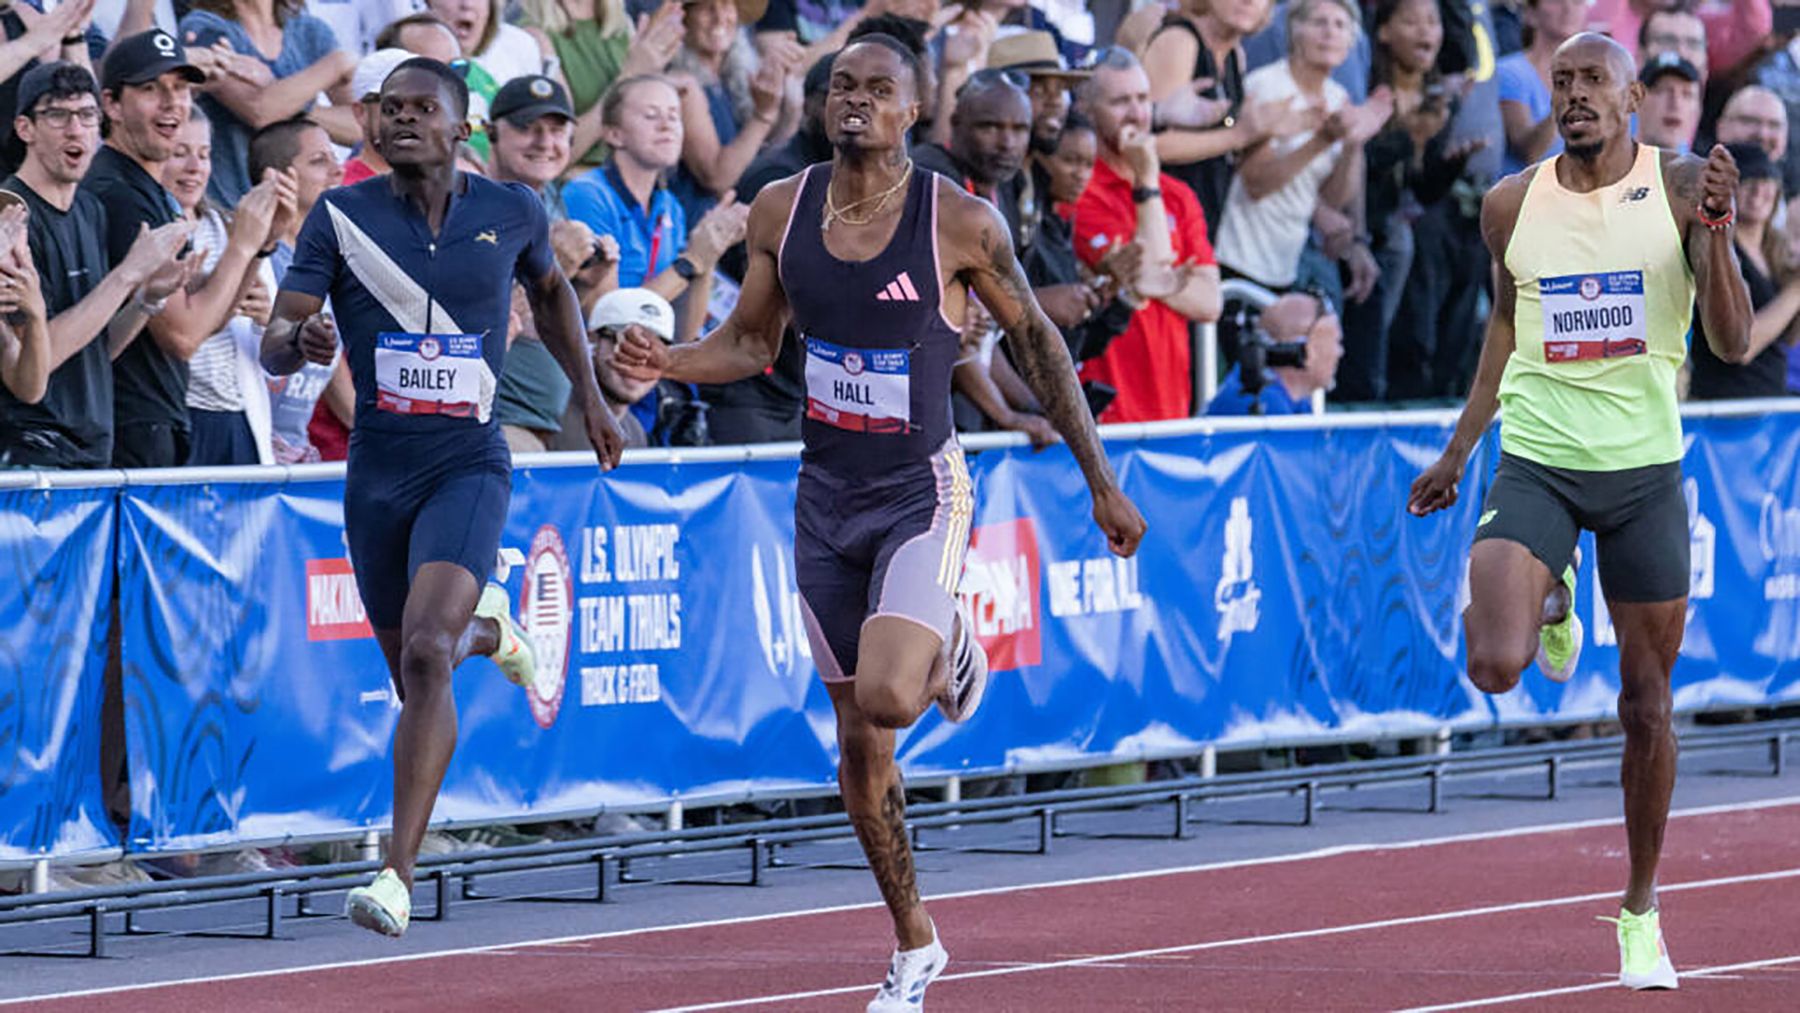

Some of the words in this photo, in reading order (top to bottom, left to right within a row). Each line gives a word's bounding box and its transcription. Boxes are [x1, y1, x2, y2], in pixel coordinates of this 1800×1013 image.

[1553, 305, 1633, 334] NORWOOD
[399, 367, 457, 390] BAILEY
[834, 379, 875, 406] HALL
[578, 596, 625, 654] TEAM
[627, 592, 681, 651] TRIALS
